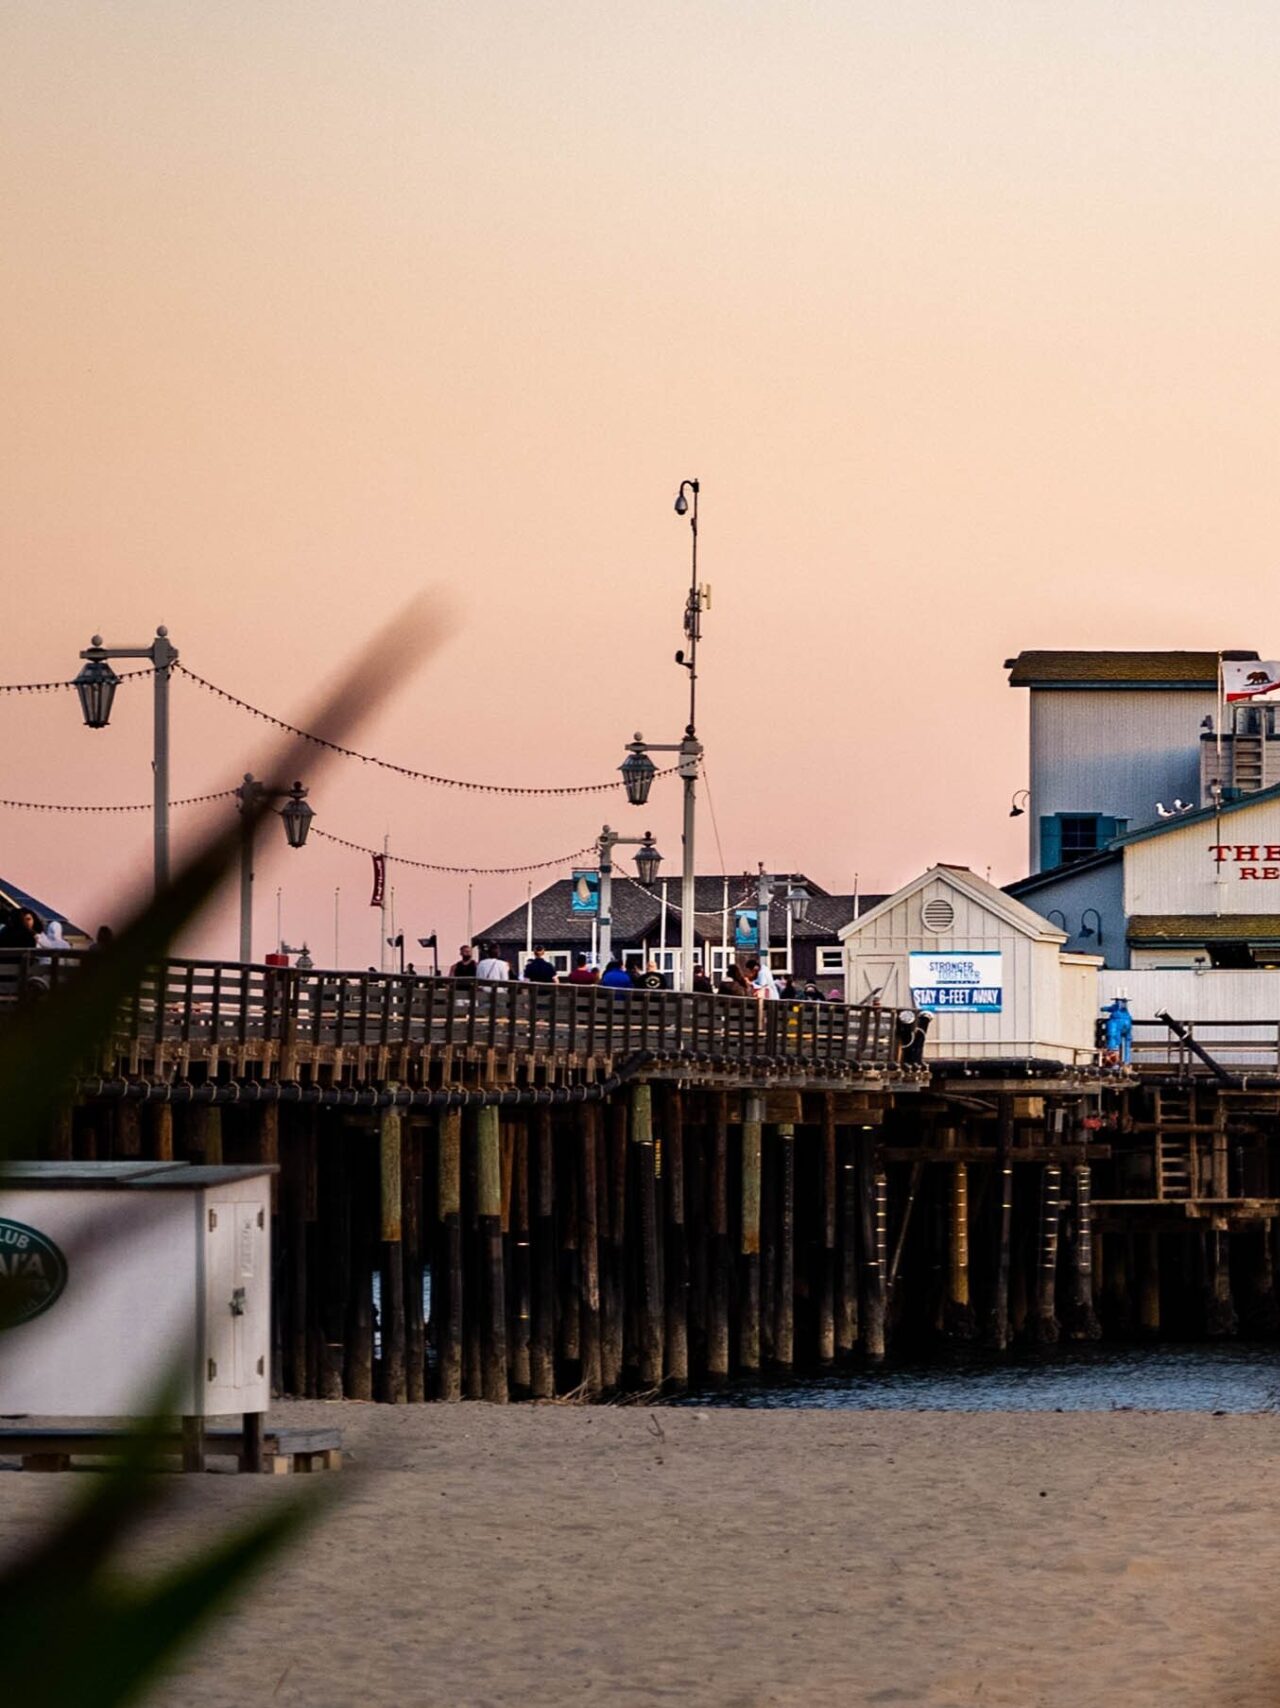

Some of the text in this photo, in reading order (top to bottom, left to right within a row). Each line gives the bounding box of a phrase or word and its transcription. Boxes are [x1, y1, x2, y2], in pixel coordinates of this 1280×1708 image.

[929, 961, 975, 972] STRONGER
[913, 989, 999, 1004] STAY 6-FEET AWAY
